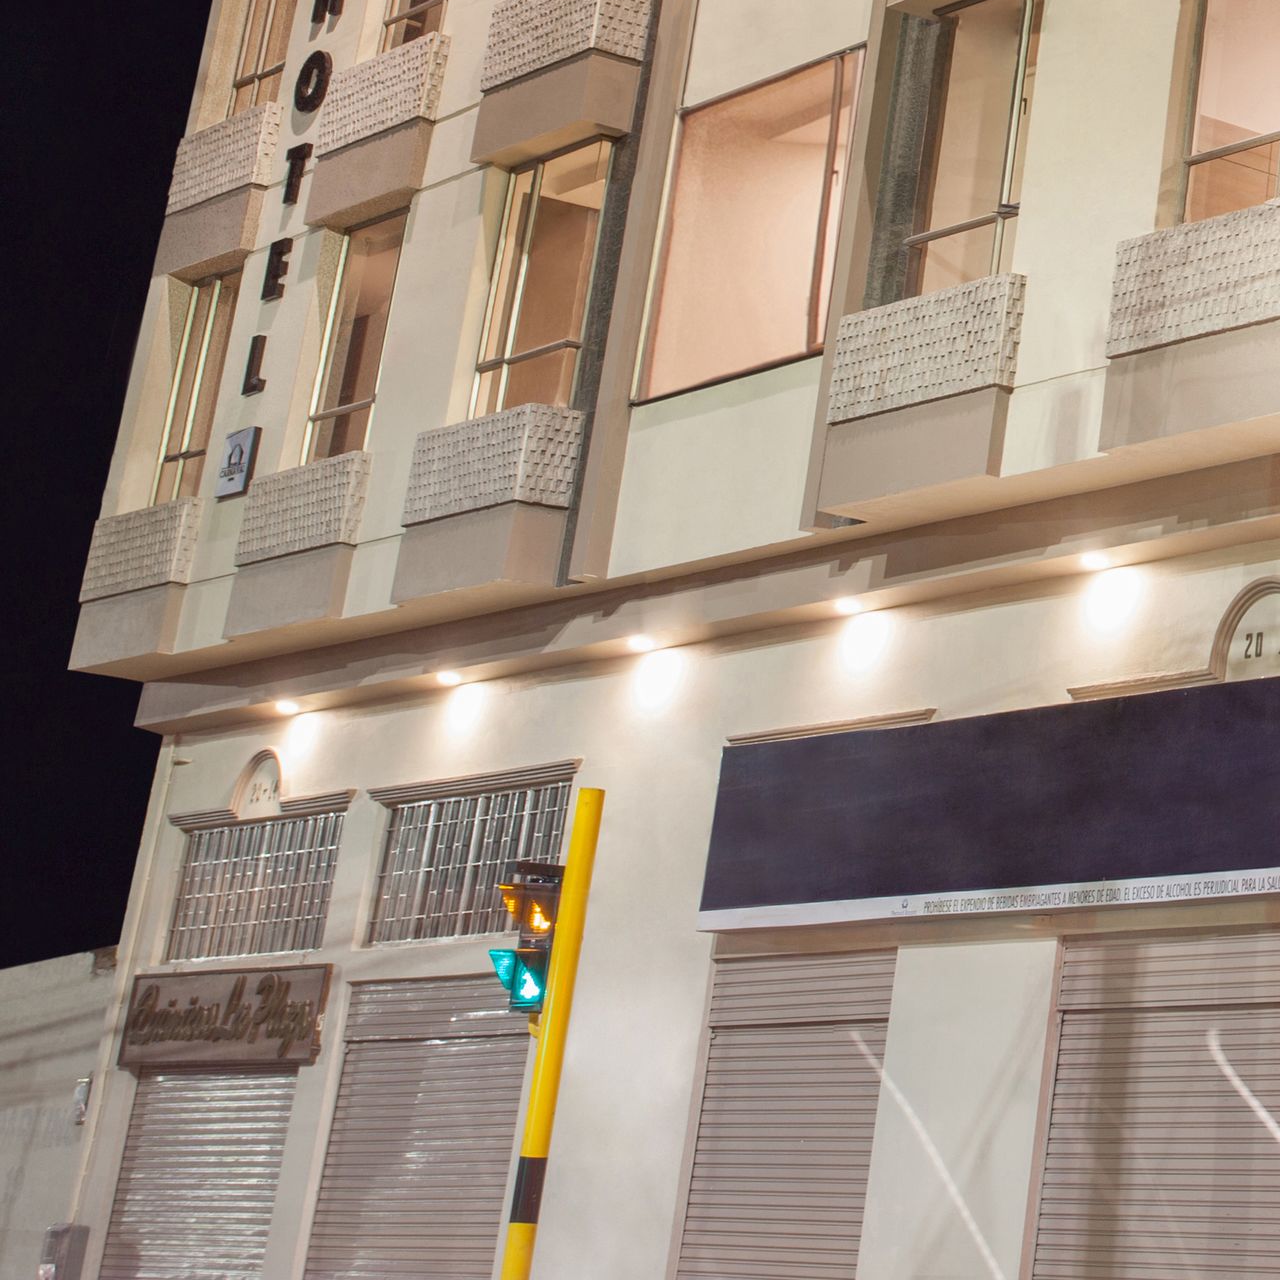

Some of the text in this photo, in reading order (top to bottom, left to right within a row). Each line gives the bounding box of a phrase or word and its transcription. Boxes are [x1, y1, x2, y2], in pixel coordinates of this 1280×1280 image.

[1244, 632, 1264, 659] 20
[987, 897, 996, 911] DE
[996, 894, 1019, 910] BEBIDAS
[1020, 891, 1061, 909] EMBRIAGANTES
[1068, 889, 1096, 905] MENORES
[1096, 888, 1105, 903] DE
[1124, 886, 1131, 901] EL
[1132, 884, 1155, 901] EXCESO
[1156, 883, 1164, 899] DE
[1166, 881, 1193, 898] ALCOHOL
[1194, 881, 1202, 896] ES
[1203, 878, 1240, 896] PERJUDICIAL
[1241, 877, 1257, 893] PARA
[1258, 877, 1266, 892] LA
